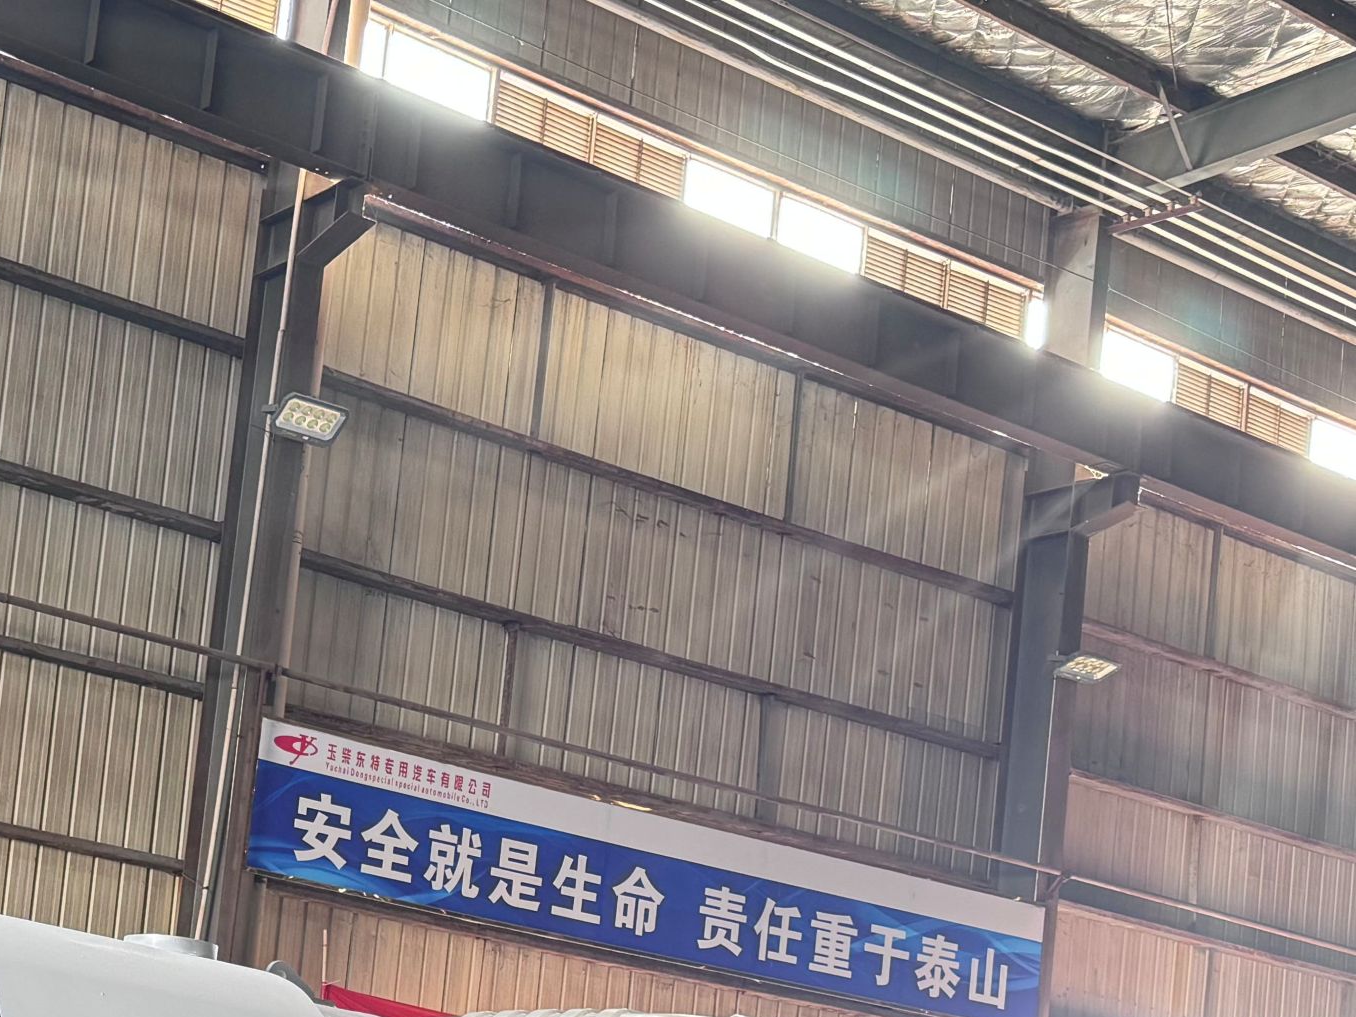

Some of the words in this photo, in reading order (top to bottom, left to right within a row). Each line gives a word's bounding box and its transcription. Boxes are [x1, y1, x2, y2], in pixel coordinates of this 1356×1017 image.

[326, 743, 492, 798] 玉柴东特专用汽车有限公司
[293, 793, 665, 936] 安全就是生命
[697, 886, 1009, 1010] 责任重于泰山
